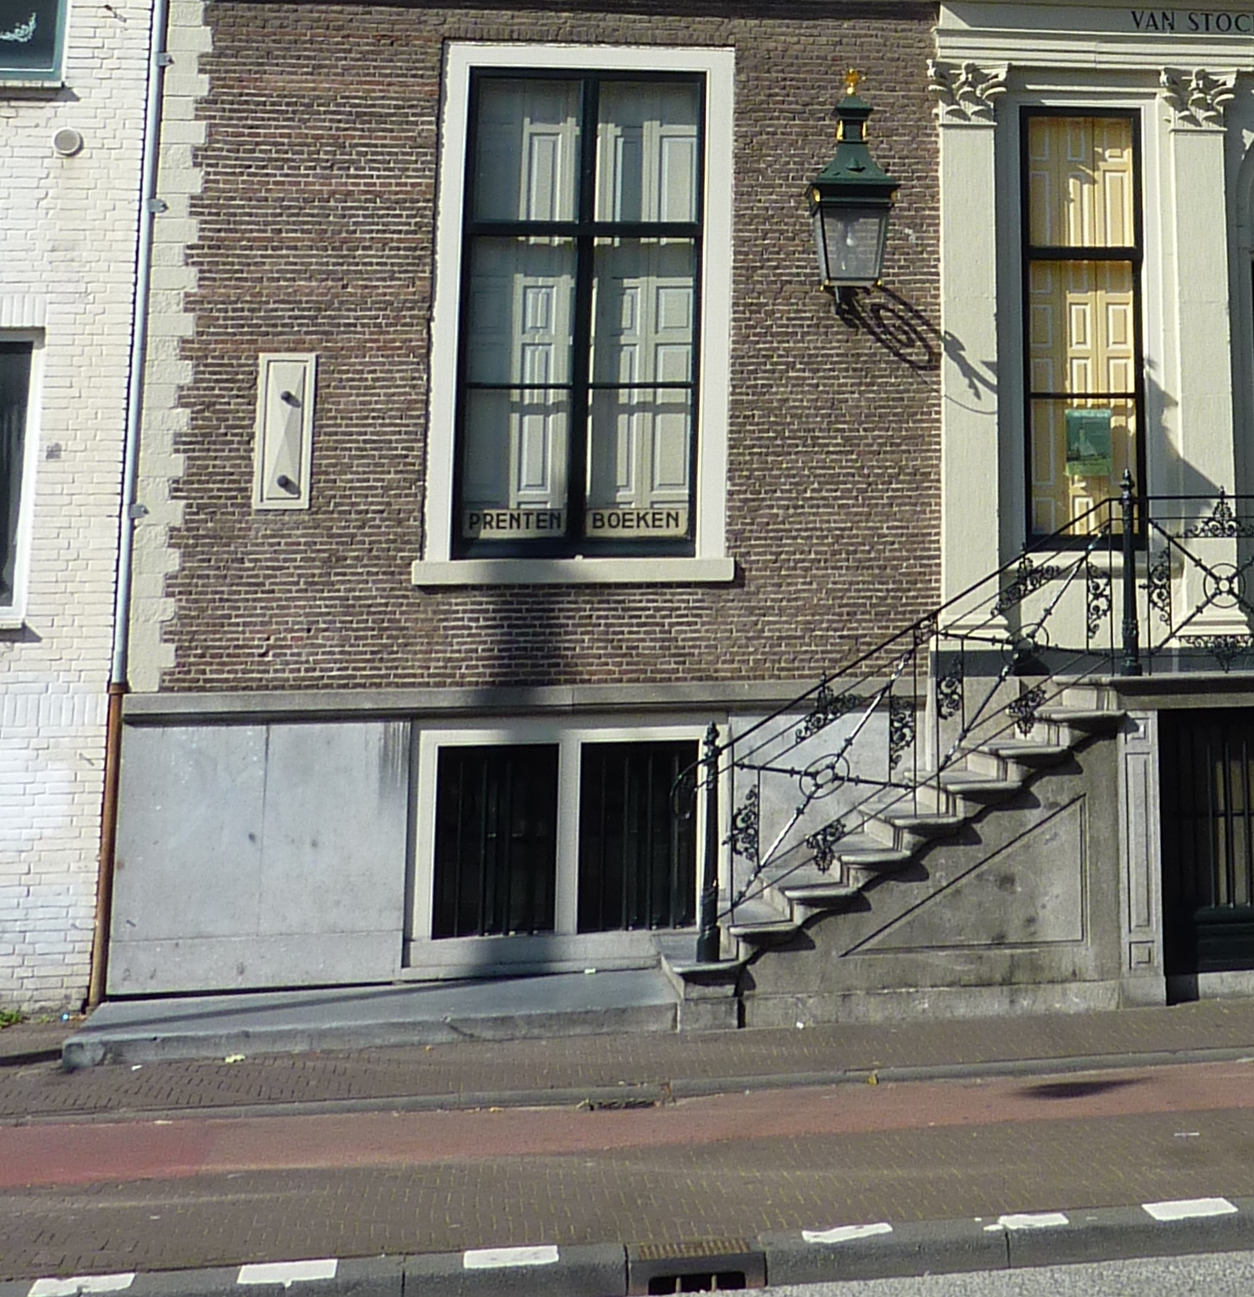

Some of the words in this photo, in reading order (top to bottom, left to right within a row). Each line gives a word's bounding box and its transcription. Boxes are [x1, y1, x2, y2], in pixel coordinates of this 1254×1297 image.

[1131, 10, 1175, 31] VAN
[468, 511, 562, 531] PRENTEN
[592, 510, 680, 530] BOEKEN
